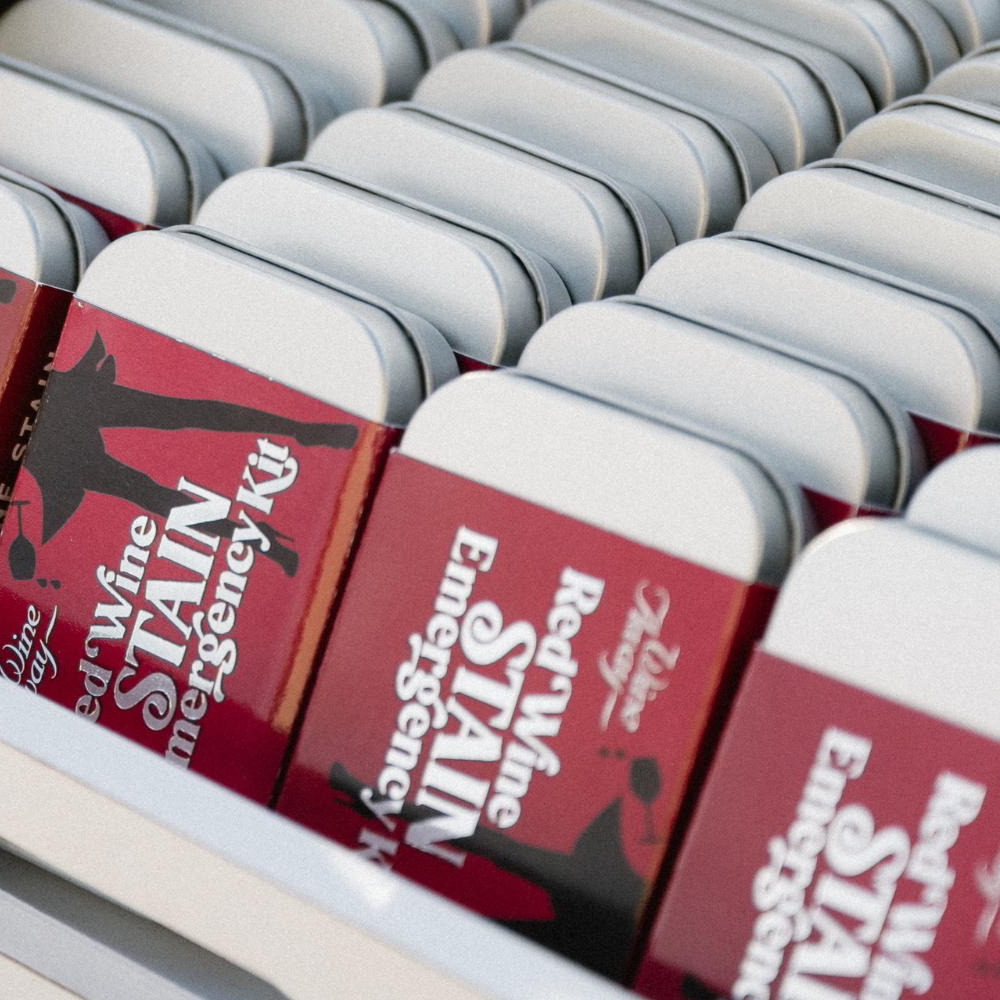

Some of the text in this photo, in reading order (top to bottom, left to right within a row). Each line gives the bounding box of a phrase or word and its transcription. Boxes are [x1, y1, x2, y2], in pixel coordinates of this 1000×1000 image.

[75, 515, 158, 722] ed Wine
[113, 476, 233, 732] STAIN
[165, 438, 300, 769] mergency Kit
[360, 525, 499, 832] Emergency
[486, 566, 606, 829] Red Wine
[619, 640, 681, 734] Wine
[404, 600, 538, 868] STAIN
[731, 725, 873, 1000] Emergenc
[778, 803, 912, 1000] STA
[858, 770, 988, 1000] Red Wi
